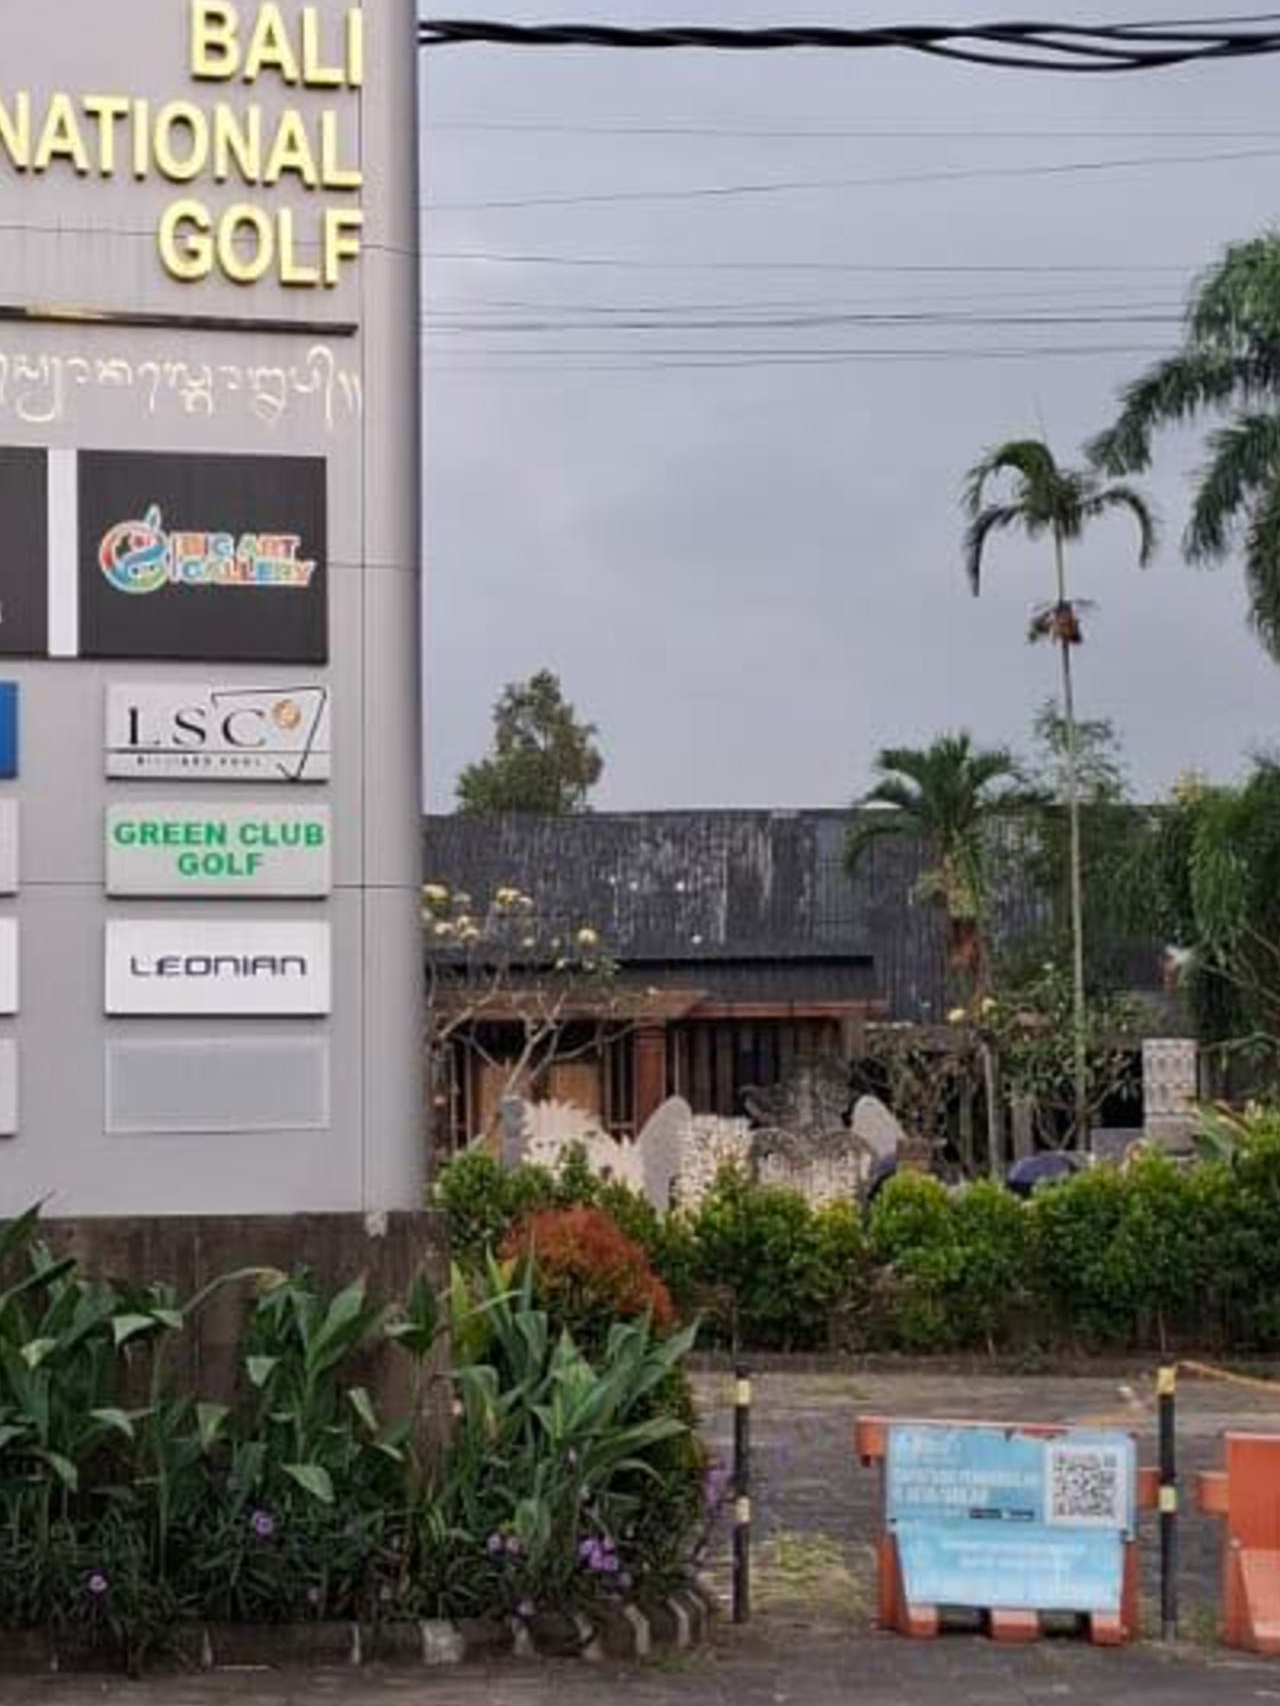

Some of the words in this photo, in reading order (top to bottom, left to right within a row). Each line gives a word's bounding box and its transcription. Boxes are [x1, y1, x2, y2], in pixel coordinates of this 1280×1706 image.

[157, 198, 363, 287] GOLF
[128, 706, 267, 748] LSC
[113, 821, 227, 846] GREEN
[238, 821, 325, 846] CLUB
[177, 852, 266, 877] GOLF
